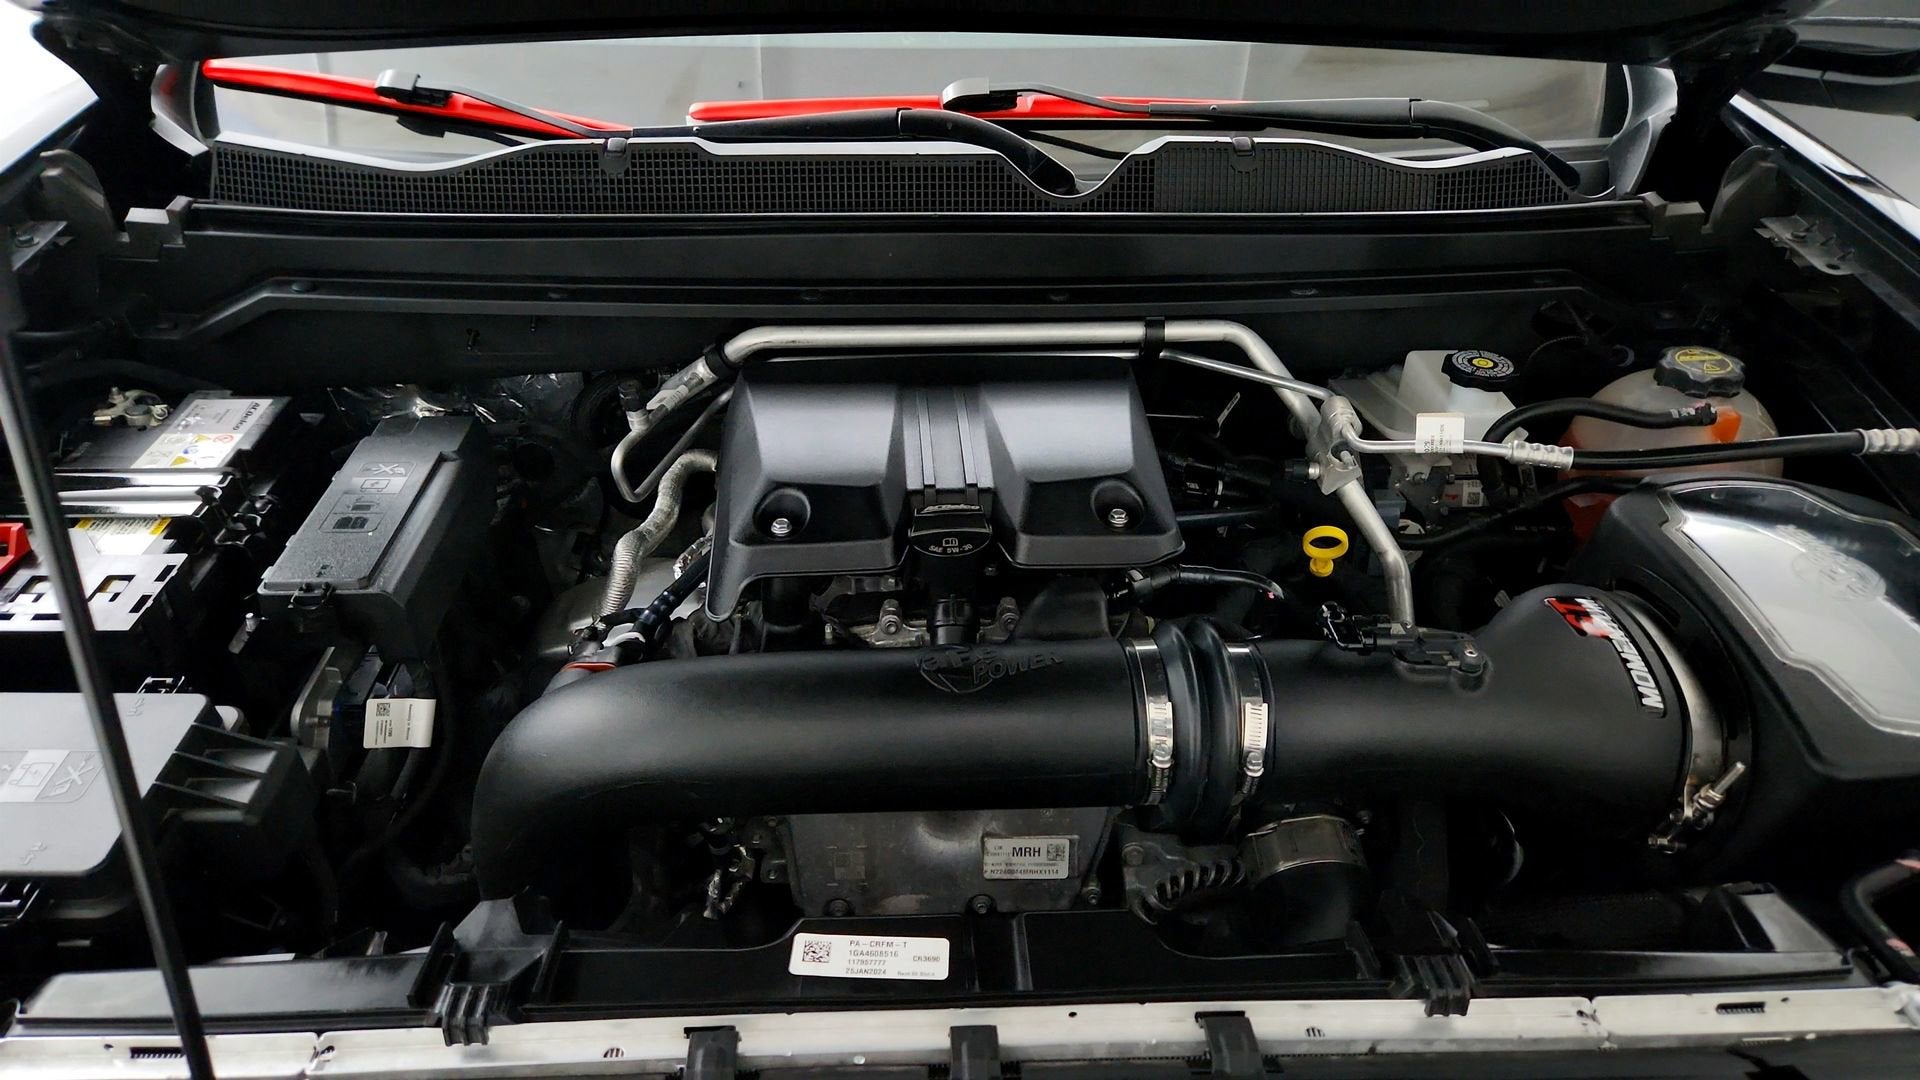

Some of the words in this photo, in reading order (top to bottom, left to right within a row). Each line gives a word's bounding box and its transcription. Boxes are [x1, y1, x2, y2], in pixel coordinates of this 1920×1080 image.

[928, 545, 944, 553] SAE
[972, 651, 1064, 685] POWER
[1012, 846, 1041, 857] MRH
[845, 967, 887, 976] 25JAN2024
